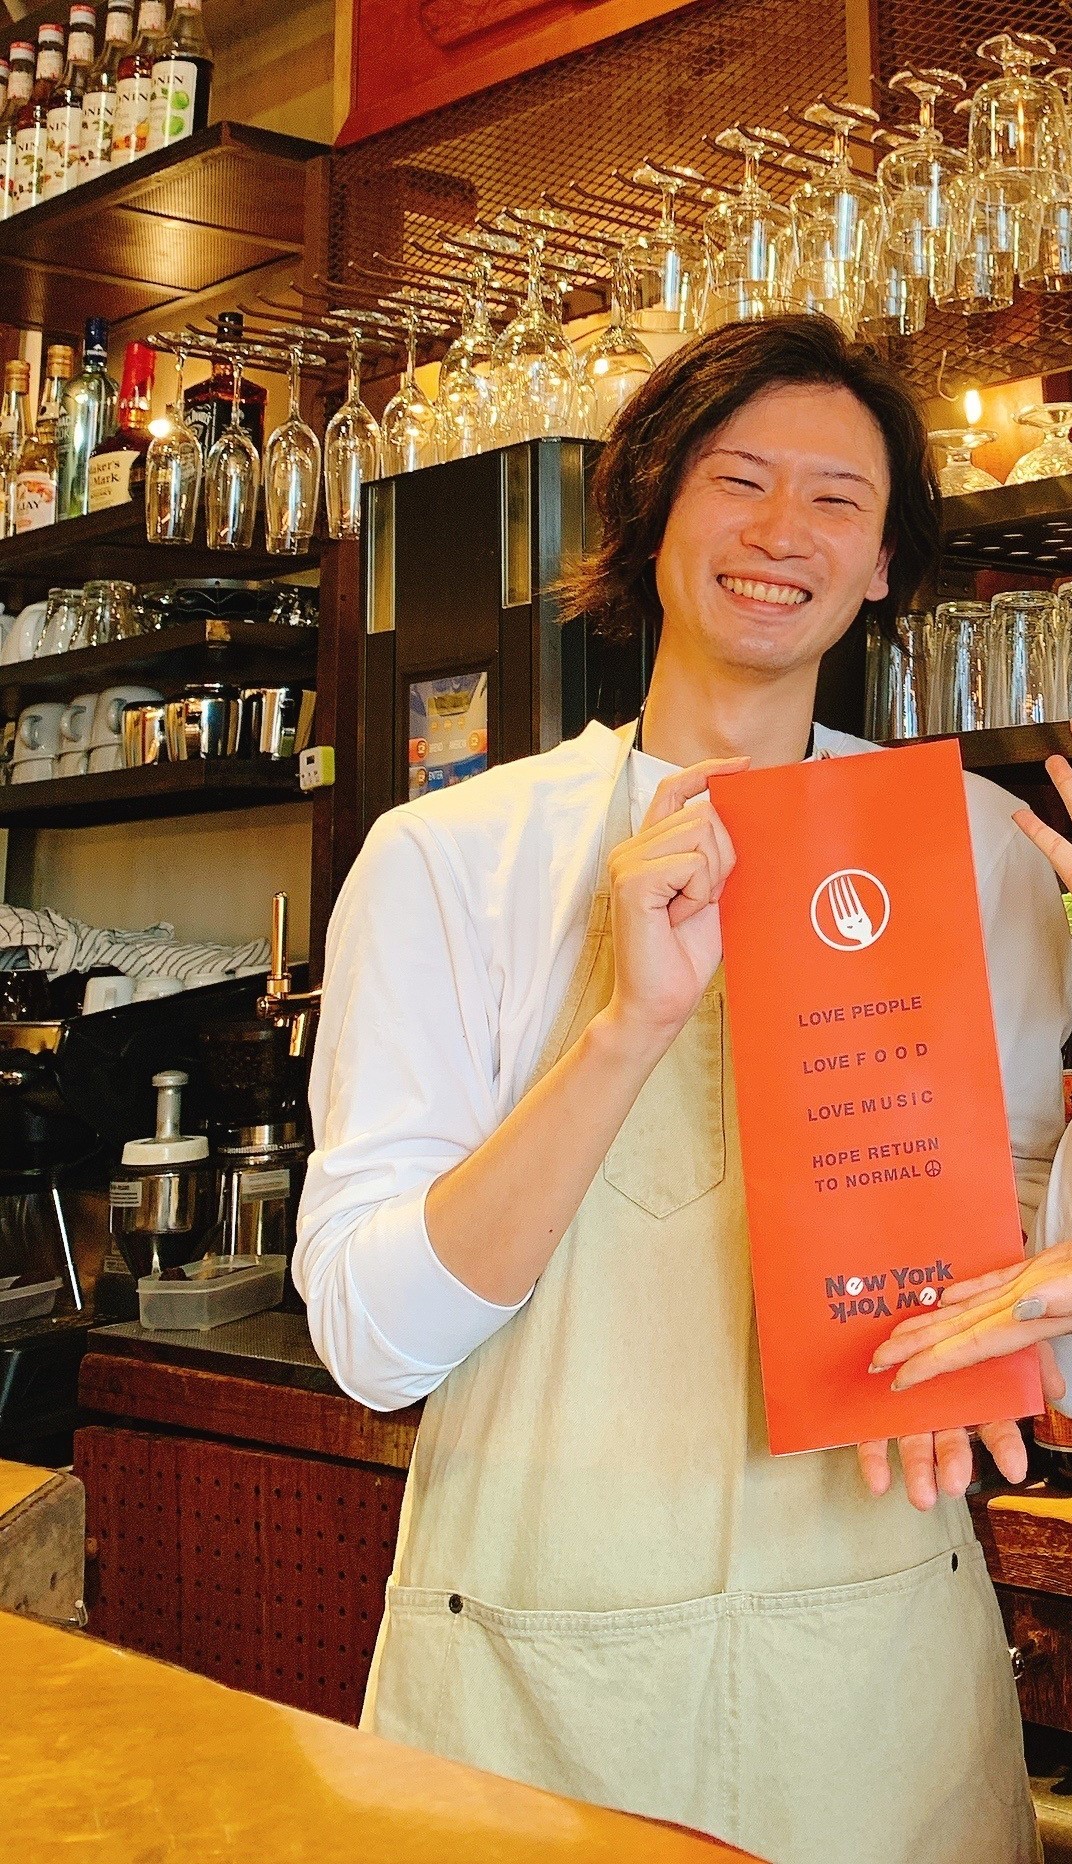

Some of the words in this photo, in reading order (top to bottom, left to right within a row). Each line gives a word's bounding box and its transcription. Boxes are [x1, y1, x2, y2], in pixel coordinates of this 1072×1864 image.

[93, 473, 120, 486] Mark
[798, 1007, 846, 1028] LOVE
[851, 996, 923, 1019] PEOPLE
[802, 1054, 850, 1075] LOVE
[807, 1101, 855, 1122] LOVE
[861, 1090, 934, 1114] MUSIC
[812, 1149, 861, 1169] HOPE
[868, 1137, 940, 1160] RETURN
[814, 1177, 839, 1193] TO
[845, 1165, 921, 1188] NORMAL
[825, 1274, 887, 1299] New
[890, 1259, 954, 1290] York
[828, 1296, 893, 1324] York
